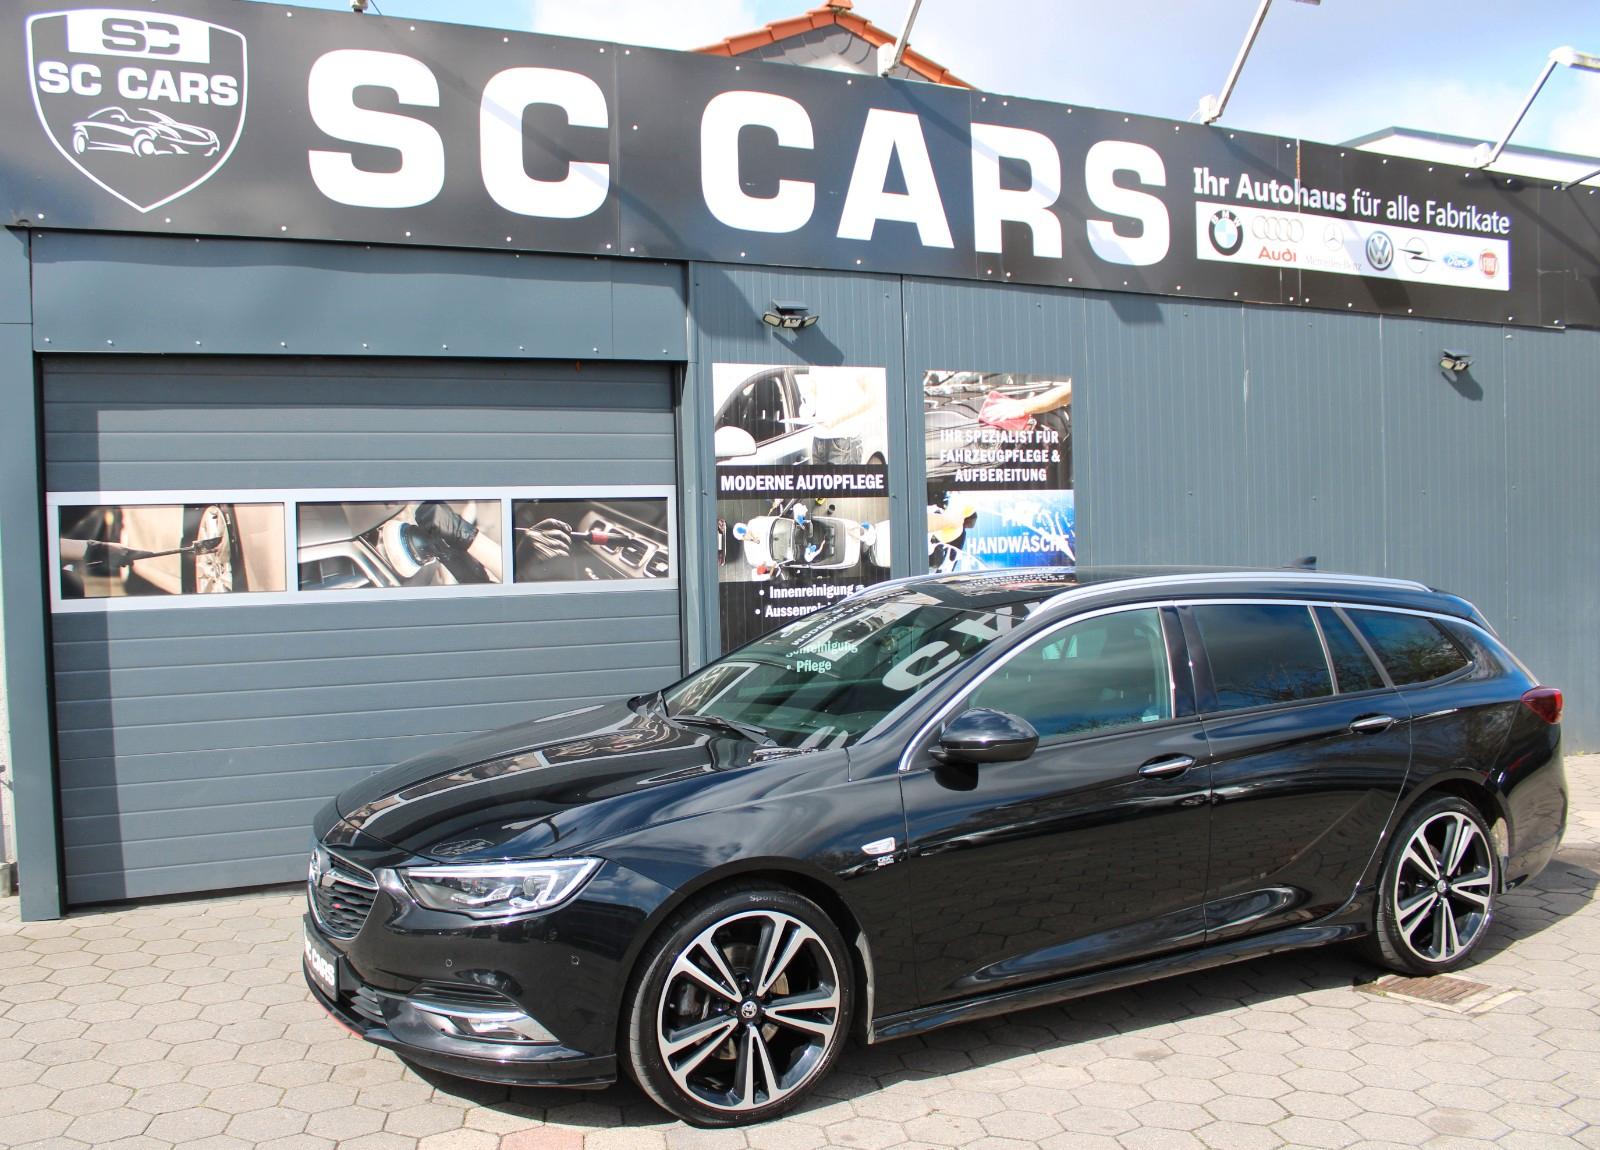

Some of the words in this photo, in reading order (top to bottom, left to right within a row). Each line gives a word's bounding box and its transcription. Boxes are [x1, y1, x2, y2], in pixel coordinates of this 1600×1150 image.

[102, 18, 180, 55] SC
[38, 61, 102, 96] SC
[118, 67, 239, 106] CARS
[308, 49, 610, 219] SC
[700, 91, 1170, 266] CARS
[1194, 167, 1229, 197] Ihr
[1236, 173, 1347, 212] Autohaus
[1352, 188, 1381, 217] für
[1386, 195, 1420, 222] alle
[1426, 200, 1510, 234] Fabrikate
[1258, 245, 1297, 262] Audi
[940, 430, 962, 443] IHR
[965, 430, 1033, 443] SPEZIALIST
[1036, 428, 1059, 443] FÜR
[940, 449, 1048, 463] FAHRZEUGPFLEGE
[1051, 450, 1060, 463] &
[721, 475, 794, 491] MODERNE
[796, 474, 884, 490] AUTOPFLEGE
[955, 468, 1047, 482] AUFBEREITUNG
[769, 584, 854, 599] Innenreinigung
[796, 660, 832, 673] Pflege
